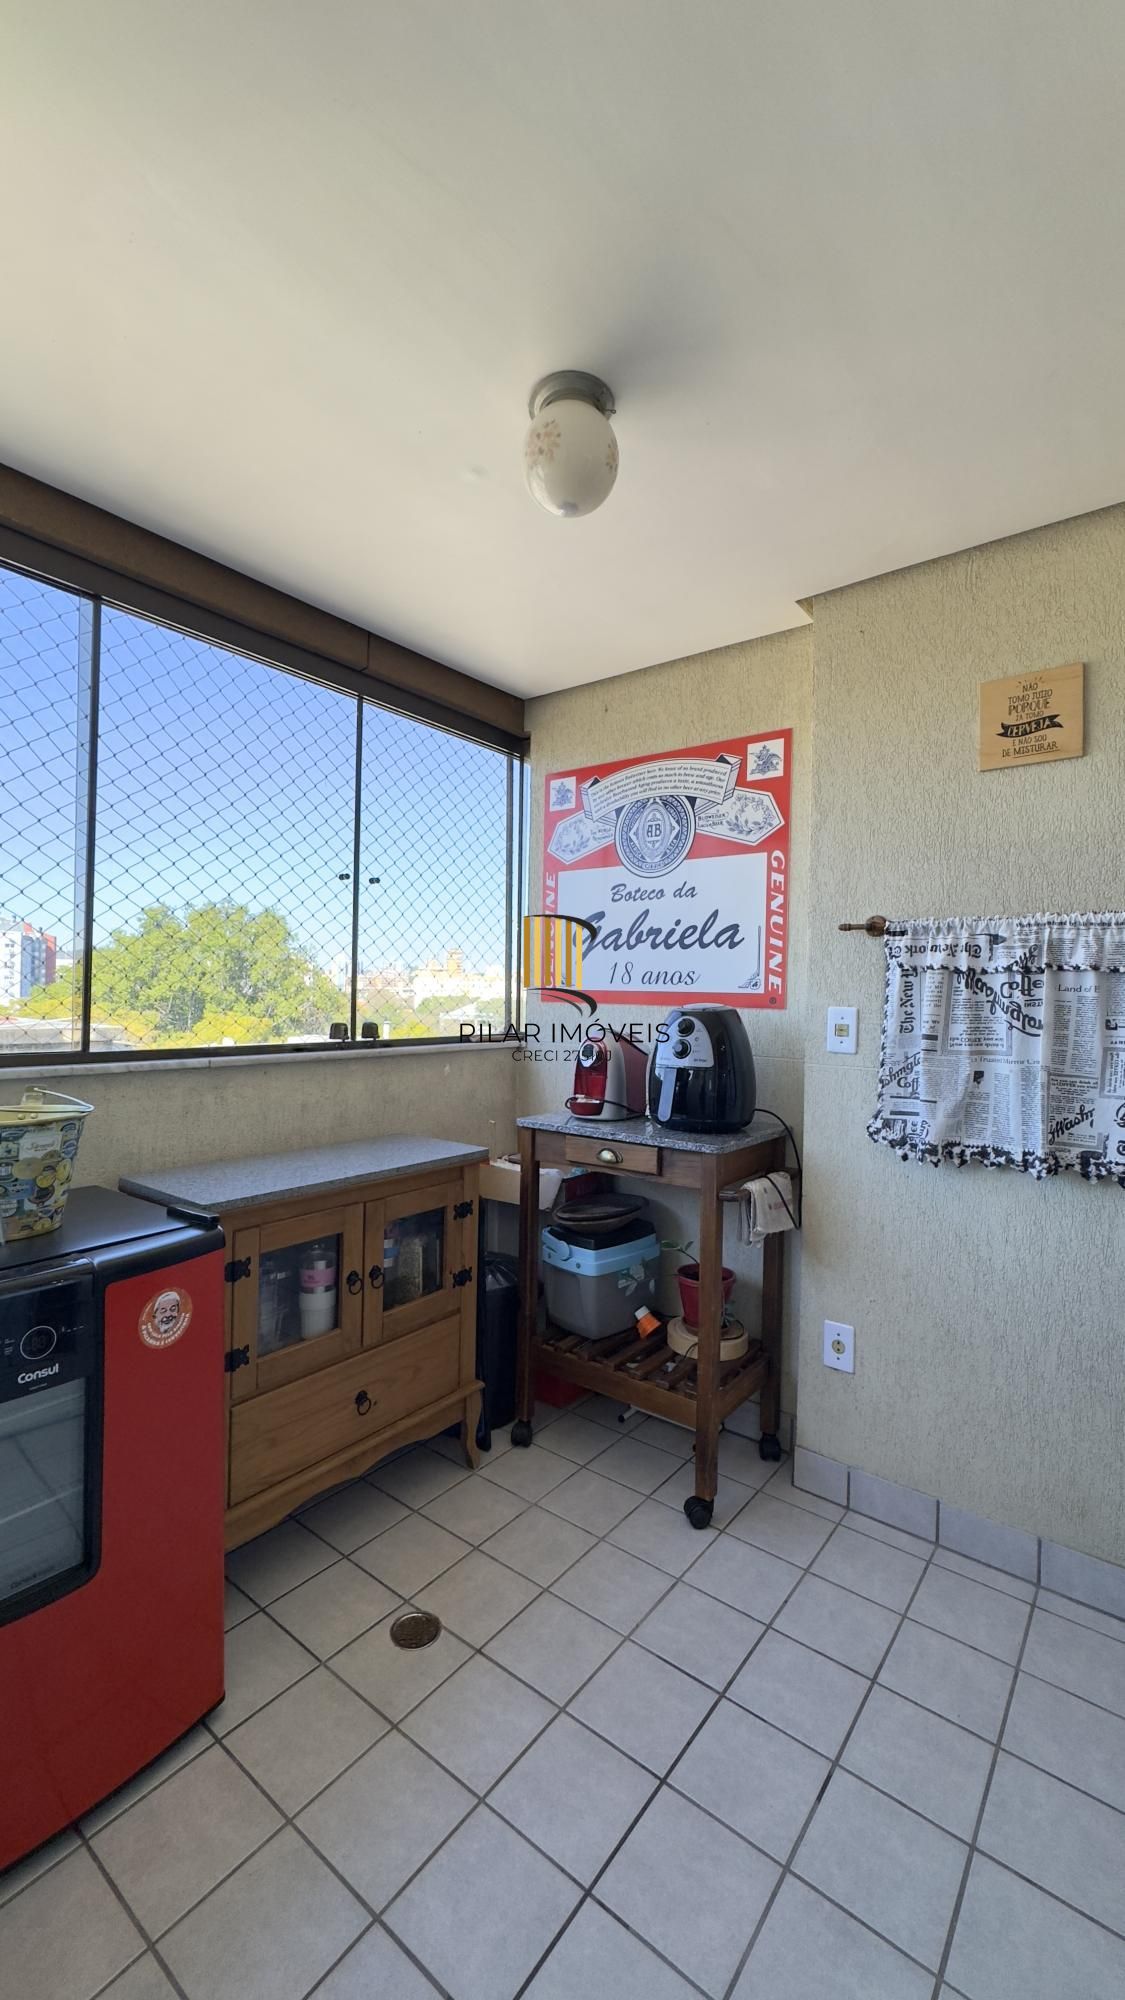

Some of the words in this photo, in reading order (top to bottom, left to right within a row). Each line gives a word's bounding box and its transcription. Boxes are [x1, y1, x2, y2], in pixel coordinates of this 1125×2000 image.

[1008, 693, 1030, 705] TOMO
[1008, 698, 1051, 716] PORQUE
[1008, 718, 1051, 737] CERVEJA
[1002, 748, 1011, 758] DE
[1013, 740, 1059, 756] MISTURAR
[1034, 734, 1048, 743] SOU
[610, 883, 666, 903] Boteco
[673, 881, 698, 899] da
[769, 850, 786, 995] GENUINE
[573, 908, 745, 964] Gabriela
[609, 961, 634, 985] 18
[641, 969, 701, 986] anos
[899, 981, 916, 1009] New
[1058, 984, 1083, 993] Land
[899, 1011, 916, 1034] The
[18, 1363, 59, 1384] Consul
